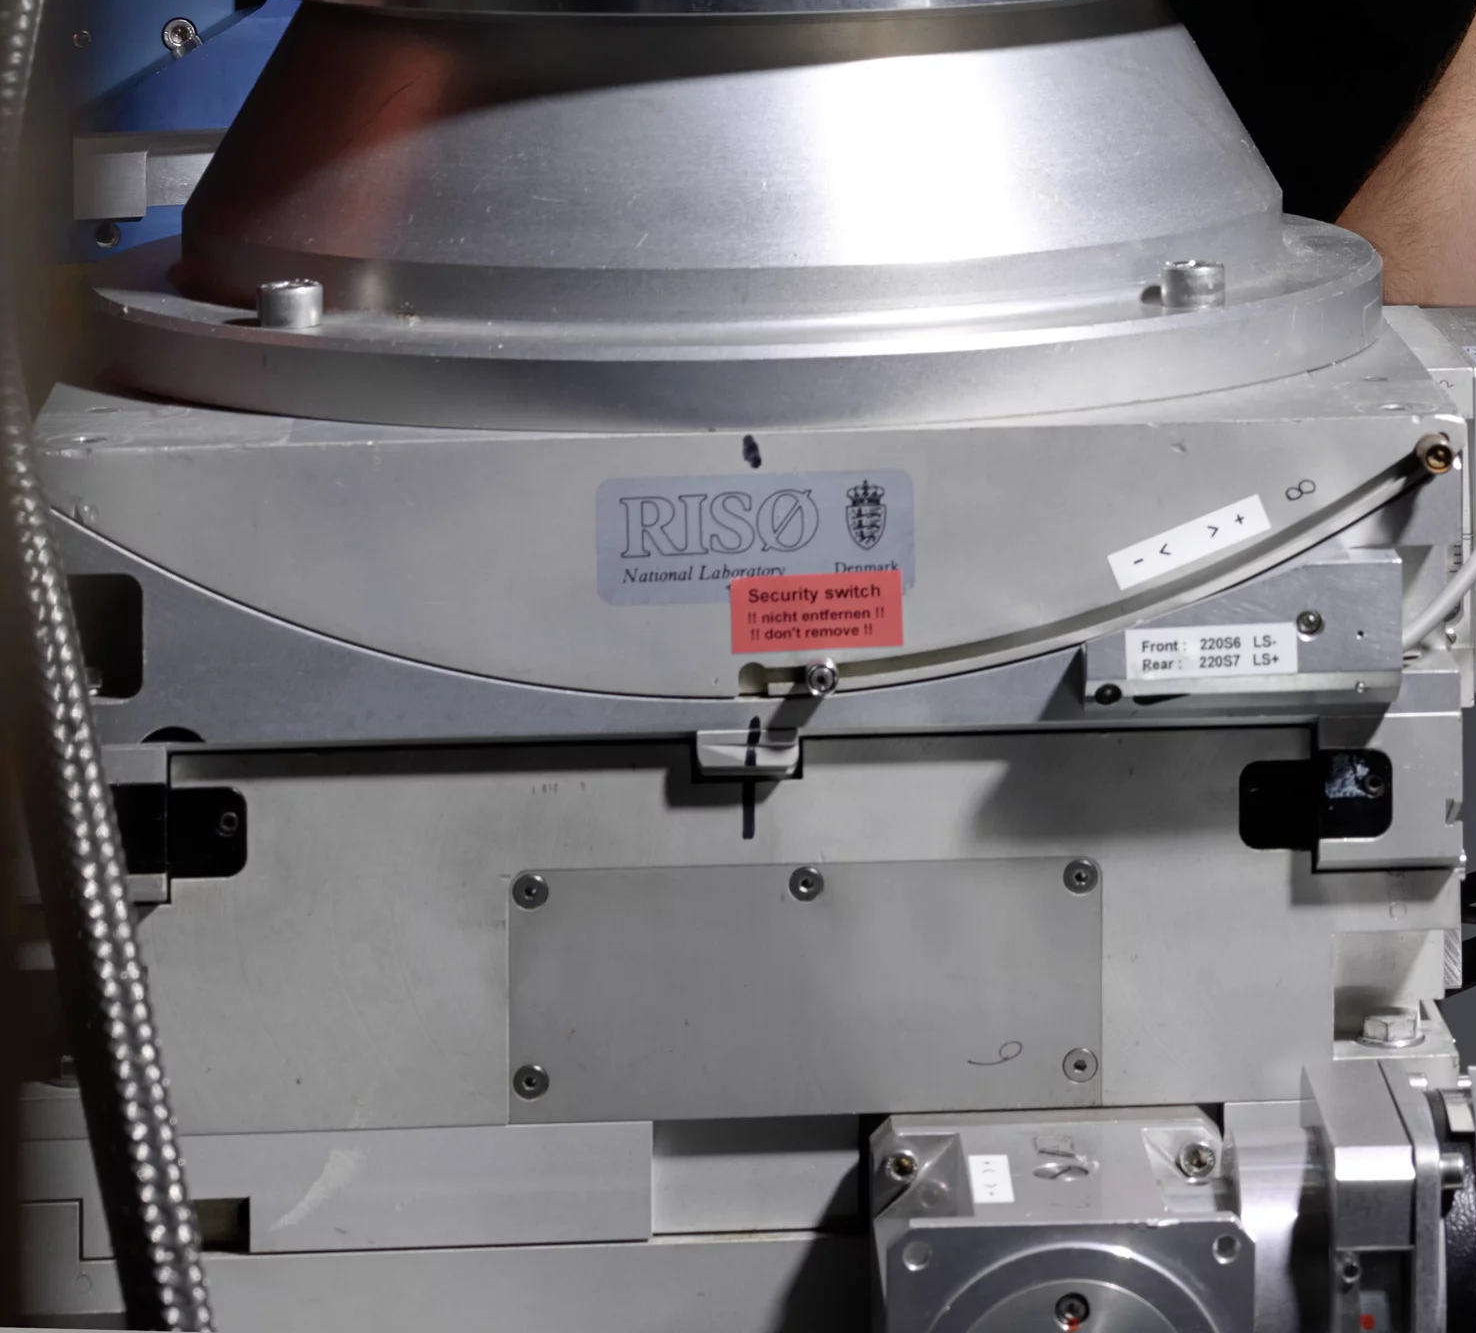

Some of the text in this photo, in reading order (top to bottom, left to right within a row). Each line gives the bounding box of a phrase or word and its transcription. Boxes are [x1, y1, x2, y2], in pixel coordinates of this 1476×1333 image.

[619, 489, 820, 559] RISØ
[622, 566, 693, 585] National
[699, 563, 787, 581] Laboratory
[748, 583, 882, 604] Security switch
[761, 611, 798, 624] nicht
[801, 608, 872, 622] entfernen
[764, 626, 802, 640] don't
[804, 626, 860, 638] remove
[1141, 639, 1179, 653] Front
[1199, 636, 1242, 650] 220S6
[1142, 657, 1175, 671] Rear
[1199, 654, 1241, 669] 220S7
[1252, 653, 1280, 666] LS+
